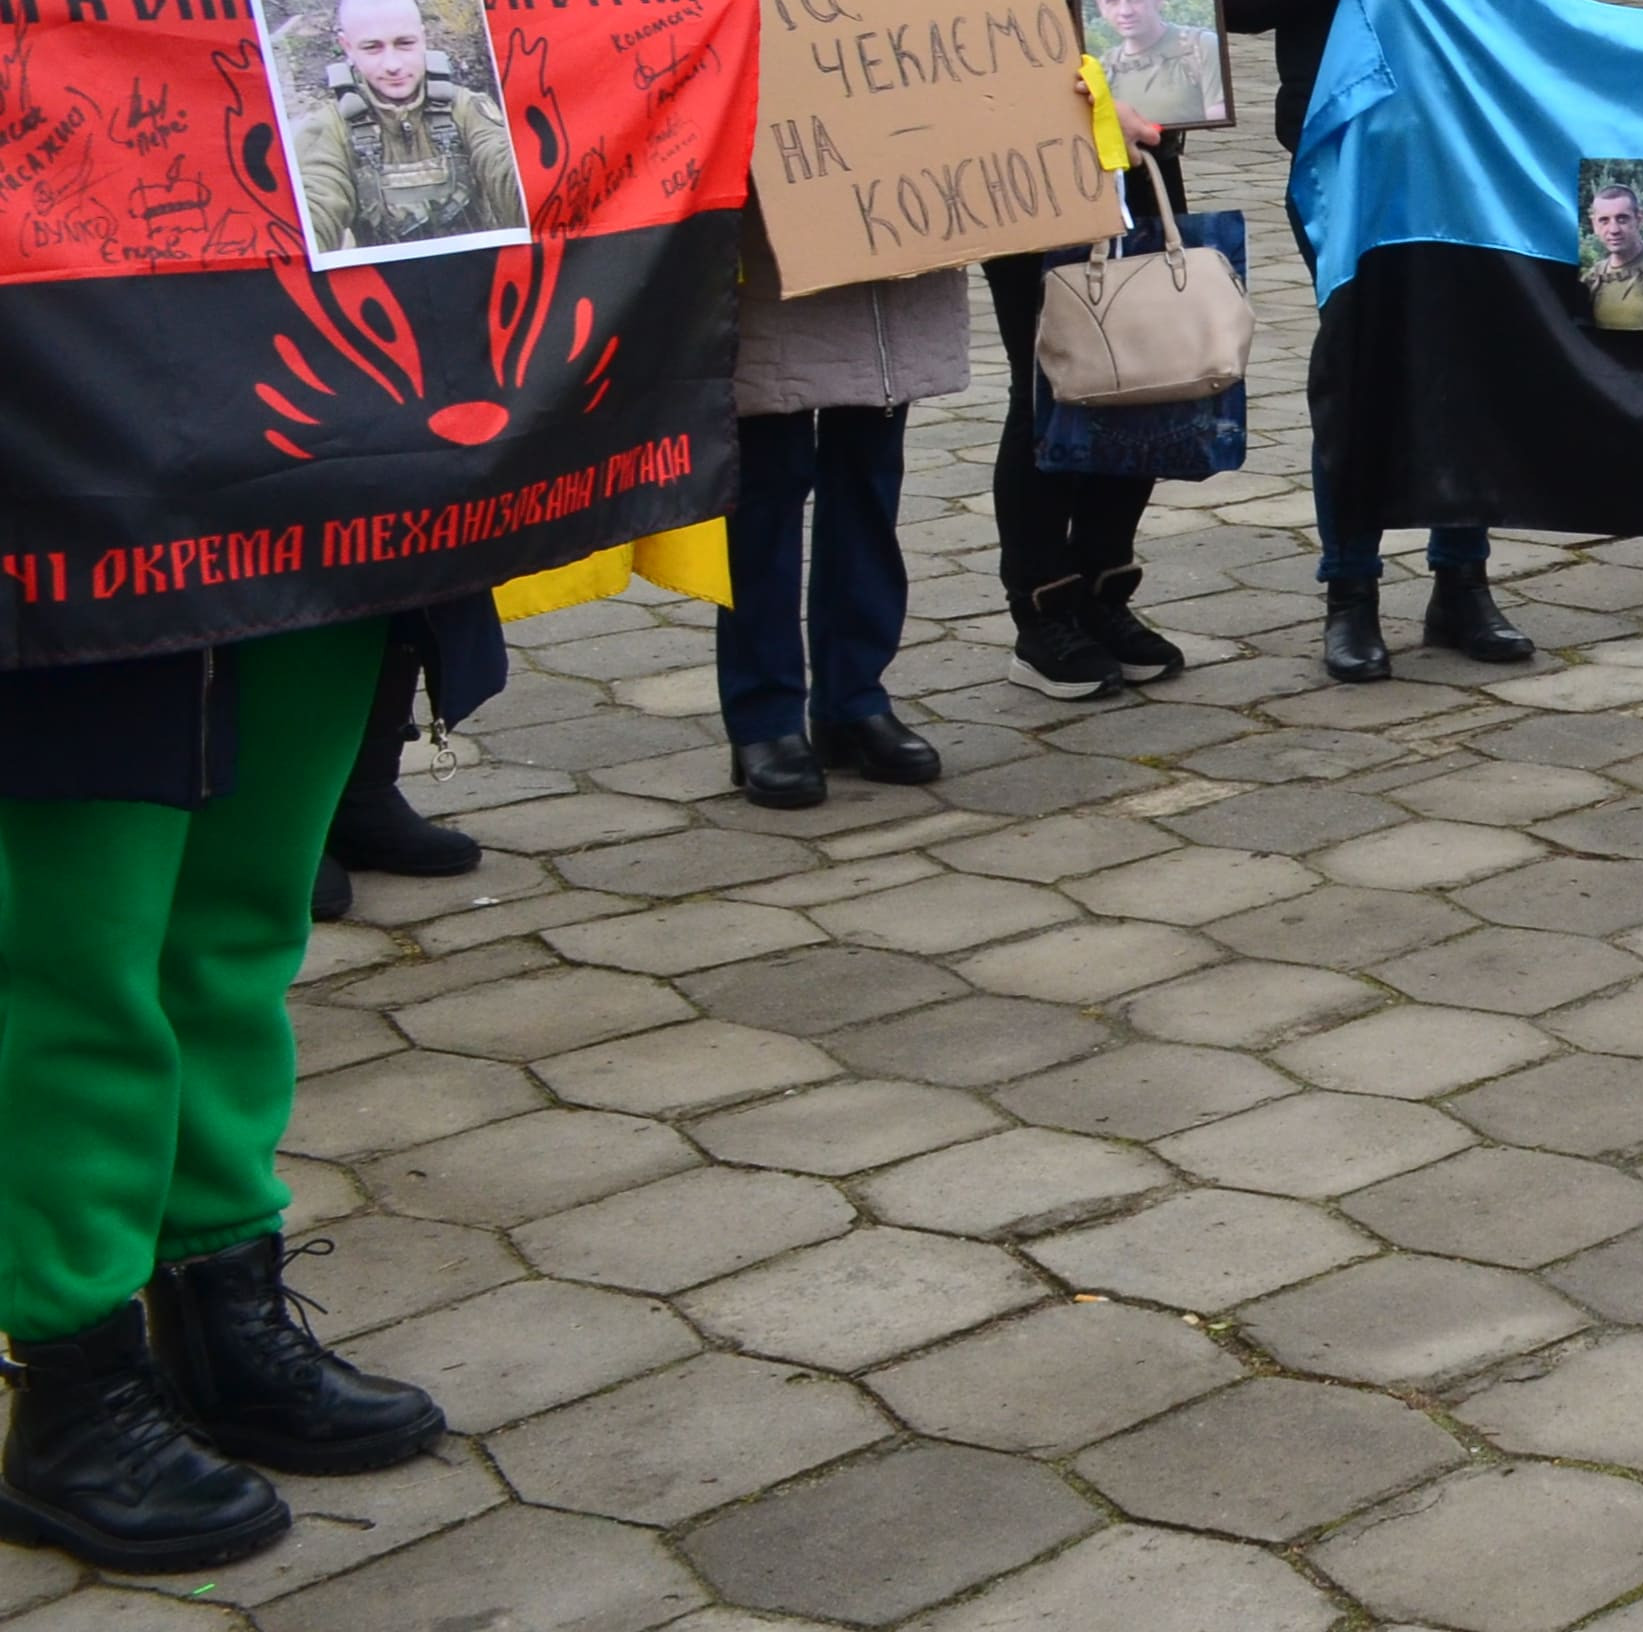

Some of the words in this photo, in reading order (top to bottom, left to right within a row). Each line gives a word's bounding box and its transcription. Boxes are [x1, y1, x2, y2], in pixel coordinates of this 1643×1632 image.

[810, 3, 1067, 98] ЧЕКАЄМО
[770, 115, 852, 184] НА
[852, 135, 1103, 255] КОЖНОГО
[93, 524, 303, 599] ОКРЕМА
[600, 433, 690, 498] РИГАДА
